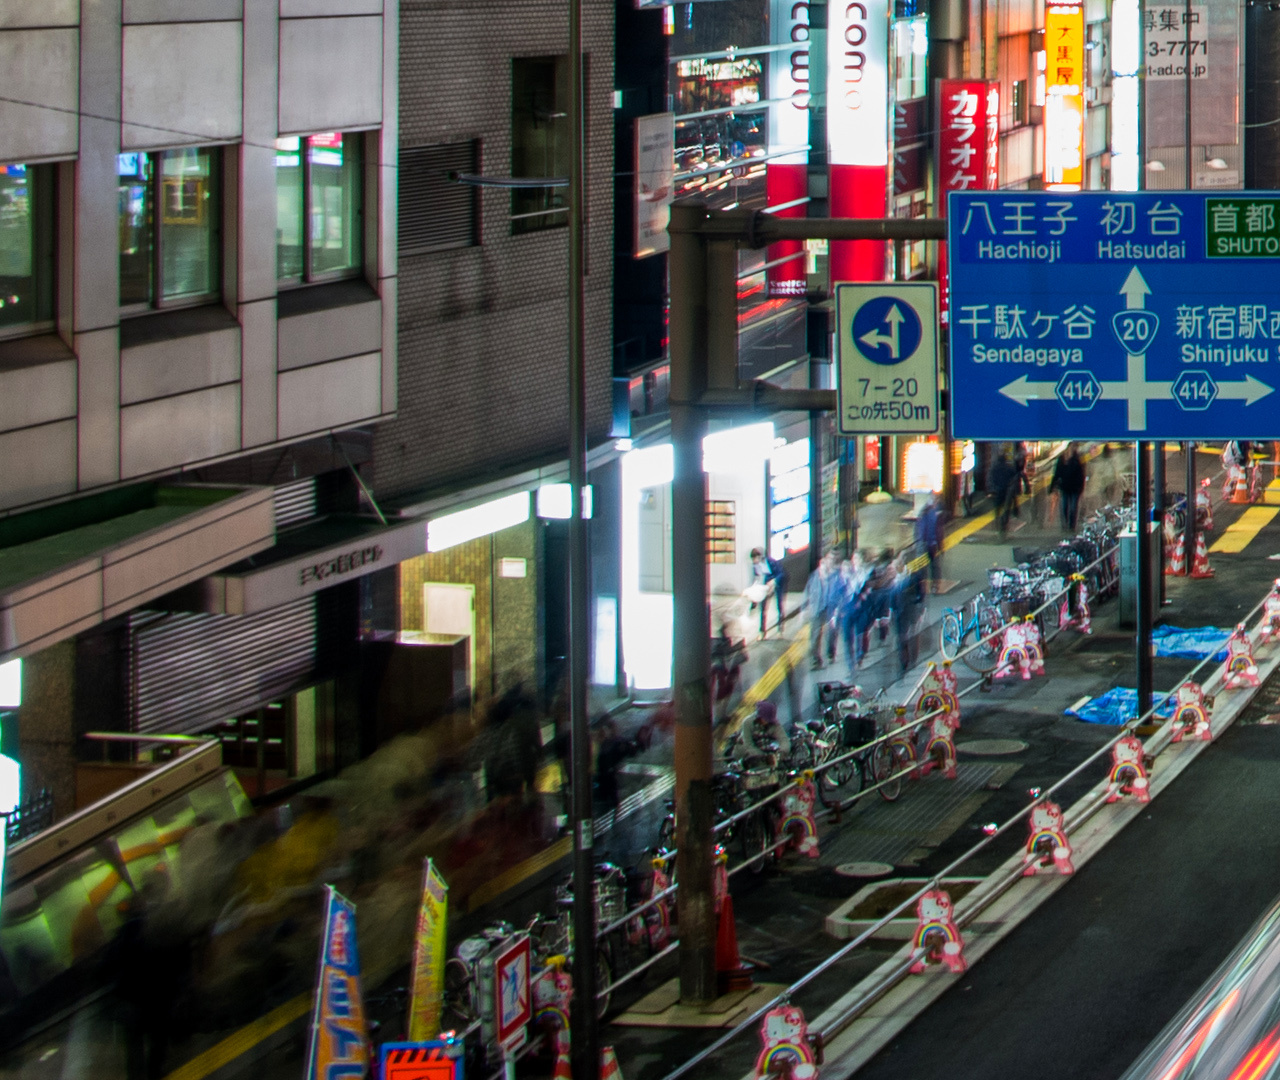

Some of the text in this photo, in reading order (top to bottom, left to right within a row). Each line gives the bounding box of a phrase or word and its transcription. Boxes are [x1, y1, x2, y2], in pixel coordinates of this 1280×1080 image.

[1055, 25, 1074, 84] 大黒屋
[1146, 41, 1209, 57] 3-7771
[948, 90, 979, 190] カラオケ
[961, 201, 1078, 237] 八王子
[1100, 200, 1185, 237] 初台
[978, 240, 1062, 264] Hachioji
[1098, 240, 1186, 261] Hatsudai
[1122, 317, 1150, 343] 20
[972, 344, 1084, 367] Sendagaya
[1181, 344, 1269, 366] Shinjuku
[858, 378, 919, 398] 7-20
[1063, 379, 1210, 402] 414 414
[847, 401, 931, 422] この先50m
